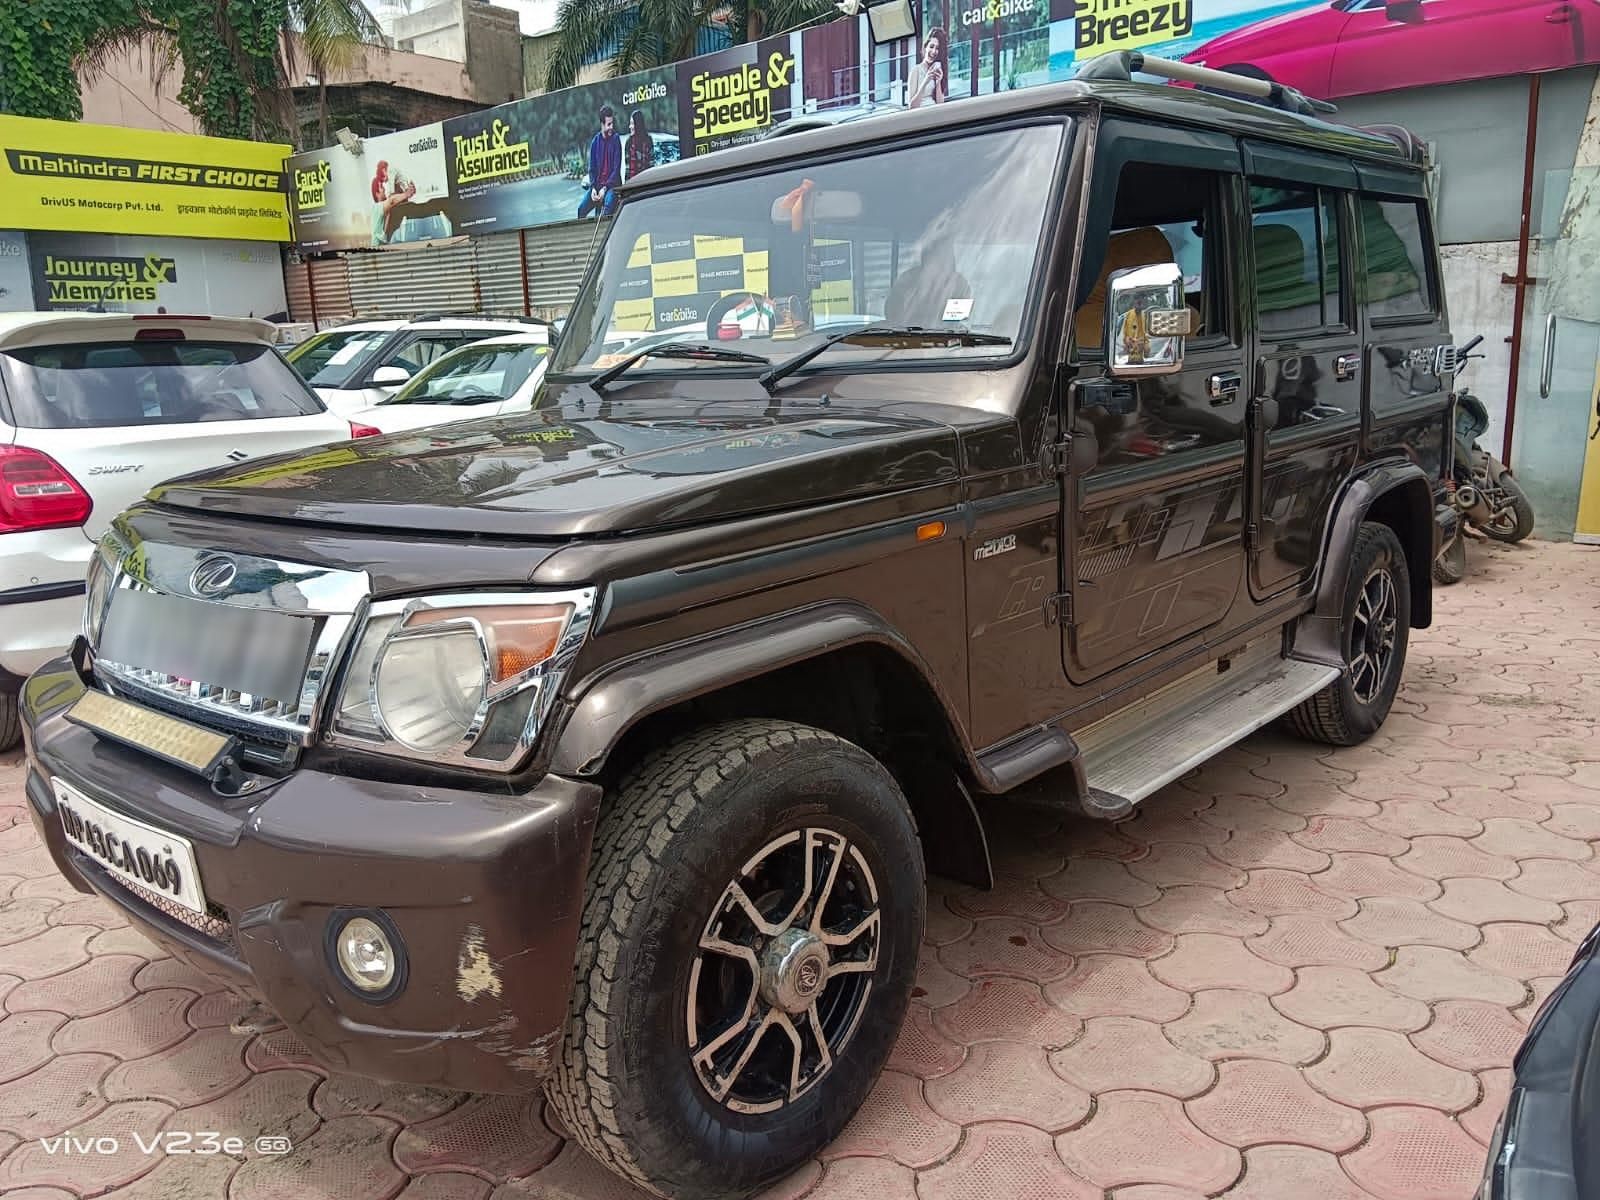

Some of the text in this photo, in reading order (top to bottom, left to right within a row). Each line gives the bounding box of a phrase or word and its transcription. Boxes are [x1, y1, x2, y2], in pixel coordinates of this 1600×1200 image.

[1075, 0, 1193, 49] Breezy
[692, 51, 795, 102] Simple &
[622, 83, 667, 105] car&bike
[693, 91, 769, 133] Speedy
[453, 119, 509, 157] Trust &
[19, 154, 279, 189] Mahindra FIRST CHOICE
[295, 160, 331, 189] Care &
[456, 147, 528, 178] Assurance
[41, 197, 164, 212] DrivUS Motocorp Pvt. Ltd.
[298, 186, 324, 206] Cover
[44, 252, 175, 283] Journey &
[49, 282, 156, 301] Memories
[660, 307, 697, 322] car&bike
[88, 464, 144, 476] SWIFT
